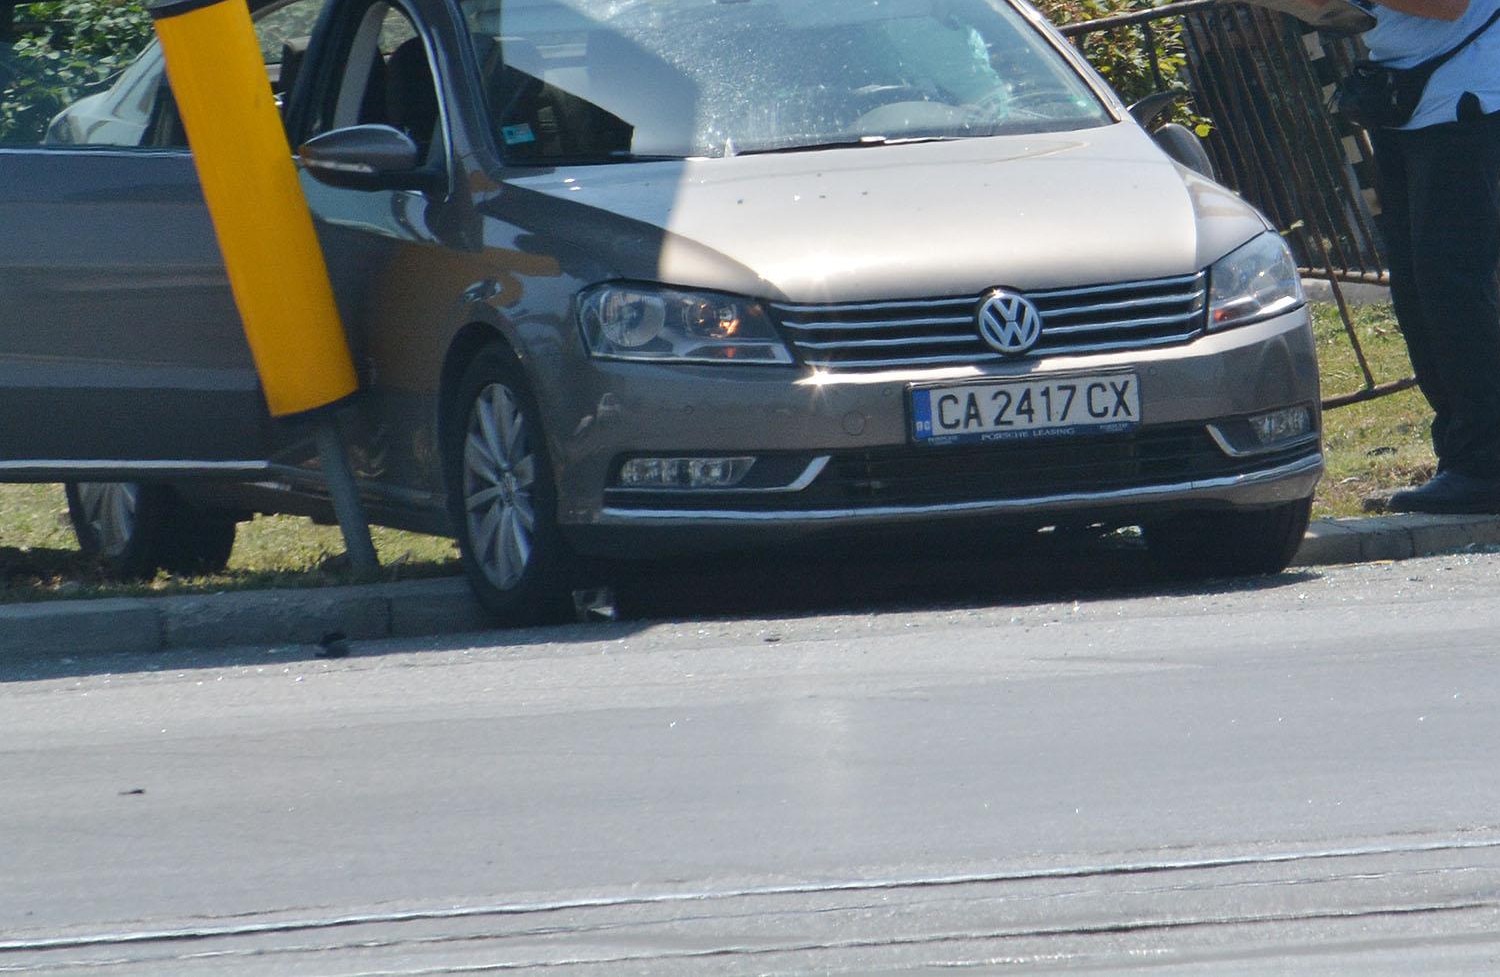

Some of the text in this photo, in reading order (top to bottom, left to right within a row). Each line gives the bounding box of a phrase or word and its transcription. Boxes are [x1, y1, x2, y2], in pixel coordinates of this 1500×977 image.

[937, 380, 1132, 430] CA 2417 CX
[1032, 426, 1076, 438] LEASING
